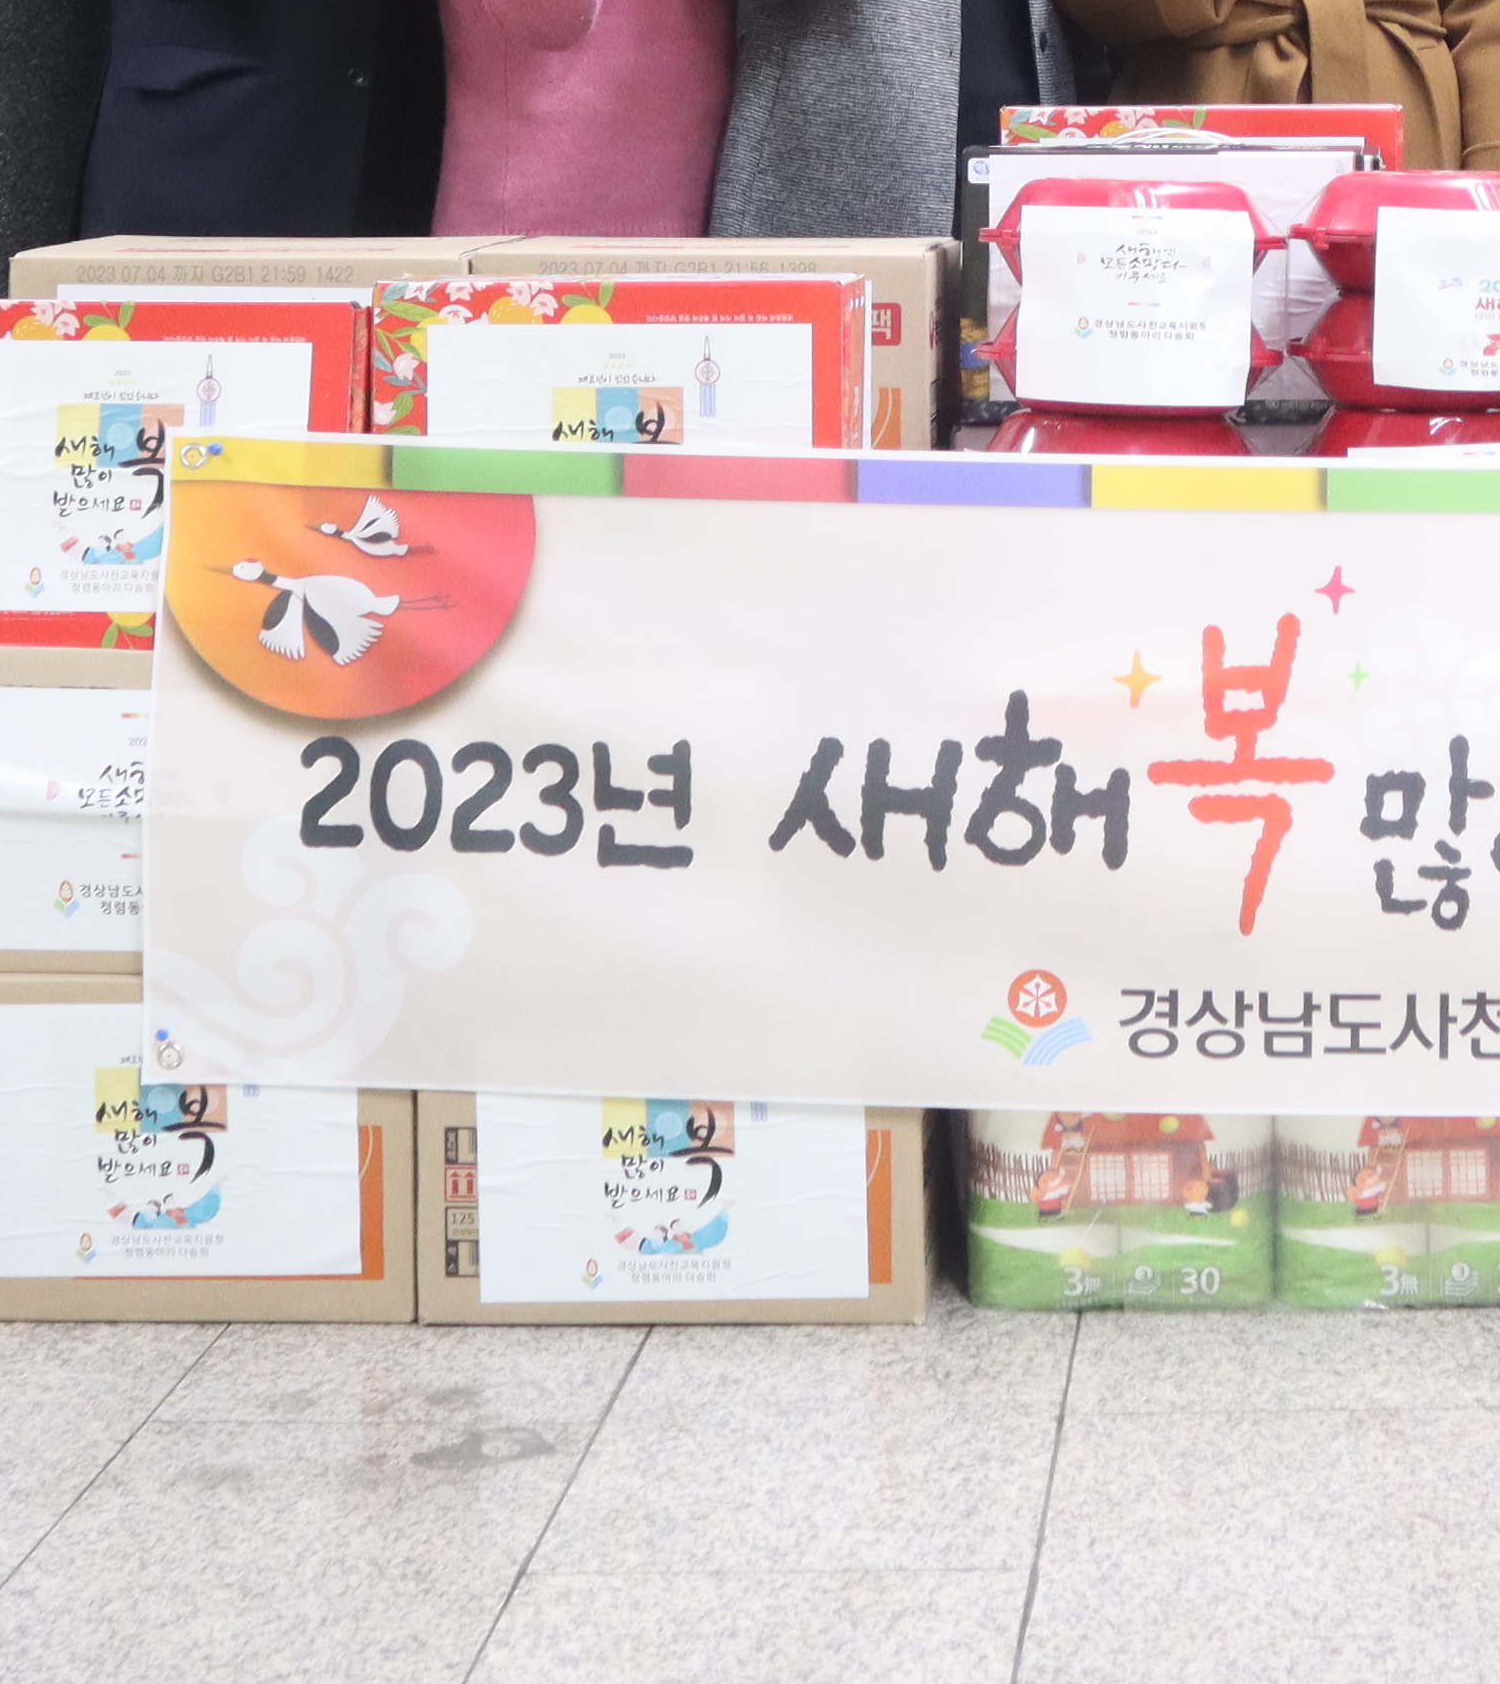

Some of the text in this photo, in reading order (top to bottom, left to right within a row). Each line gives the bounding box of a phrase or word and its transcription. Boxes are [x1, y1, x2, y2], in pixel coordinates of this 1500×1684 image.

[77, 266, 166, 284] 2023.07.04
[172, 265, 205, 283] 까지
[261, 266, 307, 284] 21:59
[315, 267, 354, 284] 1422
[552, 419, 615, 442] 새해
[55, 435, 115, 460] 새해
[71, 464, 113, 489] 많이
[53, 490, 126, 517] 받으세요
[300, 736, 694, 869] 2023년
[768, 689, 1130, 872] 새해
[1148, 614, 1332, 934] 복
[96, 1085, 227, 1184] 새해 복
[114, 1128, 157, 1154] 많이
[97, 1156, 173, 1184] 받으세요
[602, 1107, 735, 1209] 새해 복
[620, 1153, 665, 1180] 많이
[603, 1181, 680, 1209] 받으세요
[1180, 1266, 1221, 1295] 30
